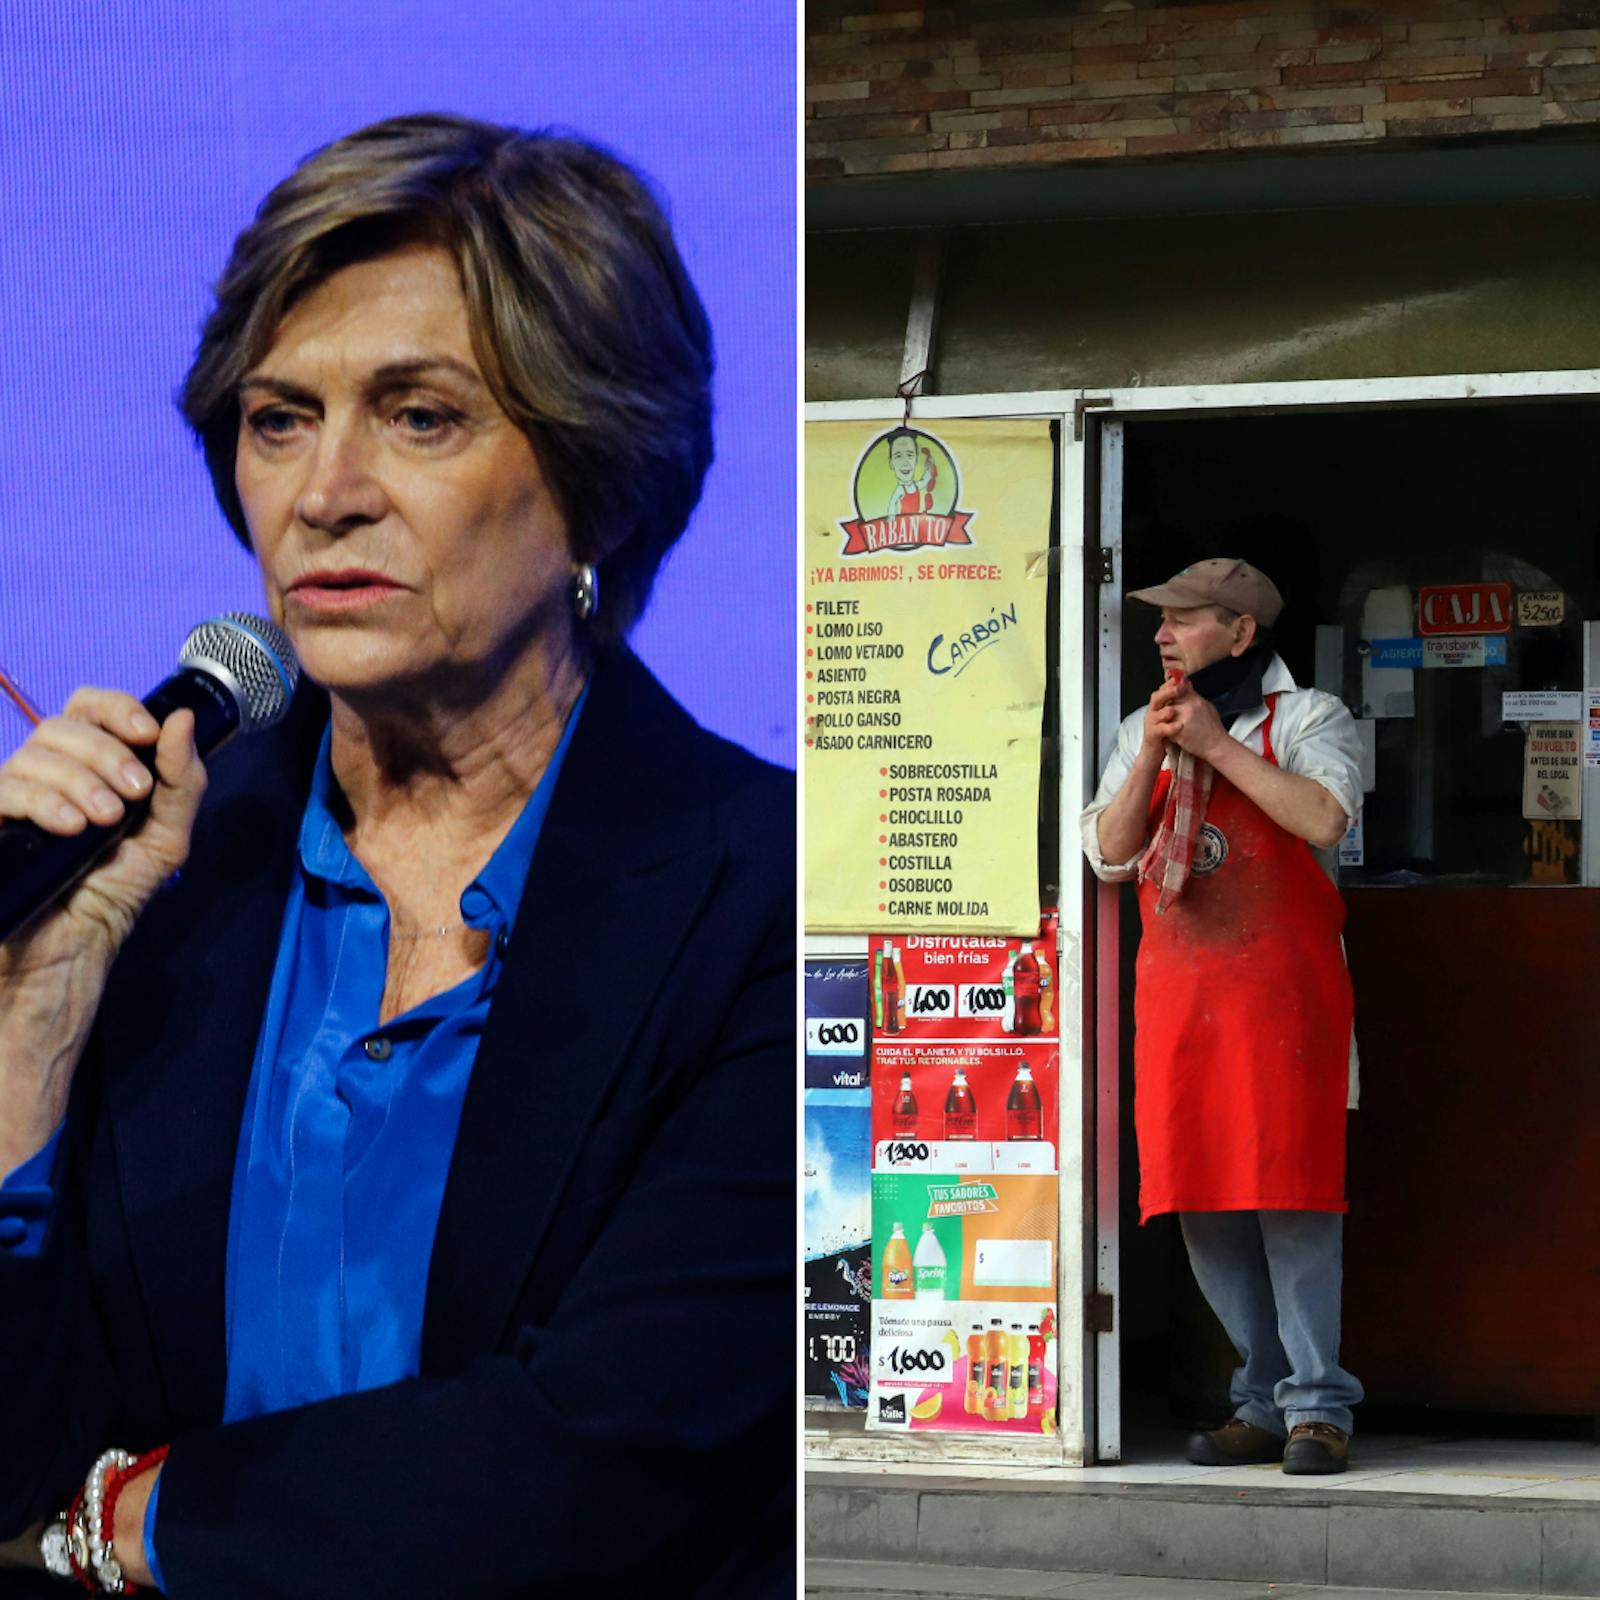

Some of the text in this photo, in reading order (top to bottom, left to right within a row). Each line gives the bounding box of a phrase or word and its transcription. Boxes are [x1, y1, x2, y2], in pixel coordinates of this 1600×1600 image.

[864, 514, 948, 550] RABANTO
[811, 566, 834, 585] ¡YA
[839, 566, 903, 582] ABRIMOS!
[917, 565, 934, 581] SE
[938, 564, 1002, 581] OFRECE:
[816, 600, 859, 615] FILETE
[1424, 591, 1506, 626] CAJA
[816, 622, 883, 637] LOMO LISO
[927, 602, 1017, 675] CARBÓN
[817, 644, 904, 660] LOMO VETADO
[817, 668, 866, 682] ASIENTO
[817, 690, 901, 705] POSTA NEGRA
[816, 712, 901, 728] POLLO GANSO
[815, 734, 933, 751] ASADO CARNICERO
[889, 764, 998, 779] SOBRECOSTILLA
[889, 787, 991, 802] POSTA ROSADA
[889, 810, 963, 824] CHOCLILLO
[889, 833, 958, 847] ABASTERO
[889, 855, 952, 870] COSTILLA
[889, 878, 952, 893] OSOBUCO
[888, 901, 989, 916] CARNE MOLIDA
[924, 951, 990, 964] bien frías
[818, 1022, 858, 1045] 600
[876, 1047, 1025, 1056] CUIDA EL PLANETA Y TU BOLSILLO.
[876, 1057, 983, 1065] TRAE TUS RETORNABLES.
[833, 1071, 861, 1086] vital
[933, 1186, 989, 1201] TUS SABORES
[934, 1200, 985, 1215] FAVORITOS
[979, 1253, 985, 1263] $
[818, 1304, 860, 1312] LEMONADE
[927, 1318, 952, 1328] pausa
[881, 1408, 904, 1419] Valle
